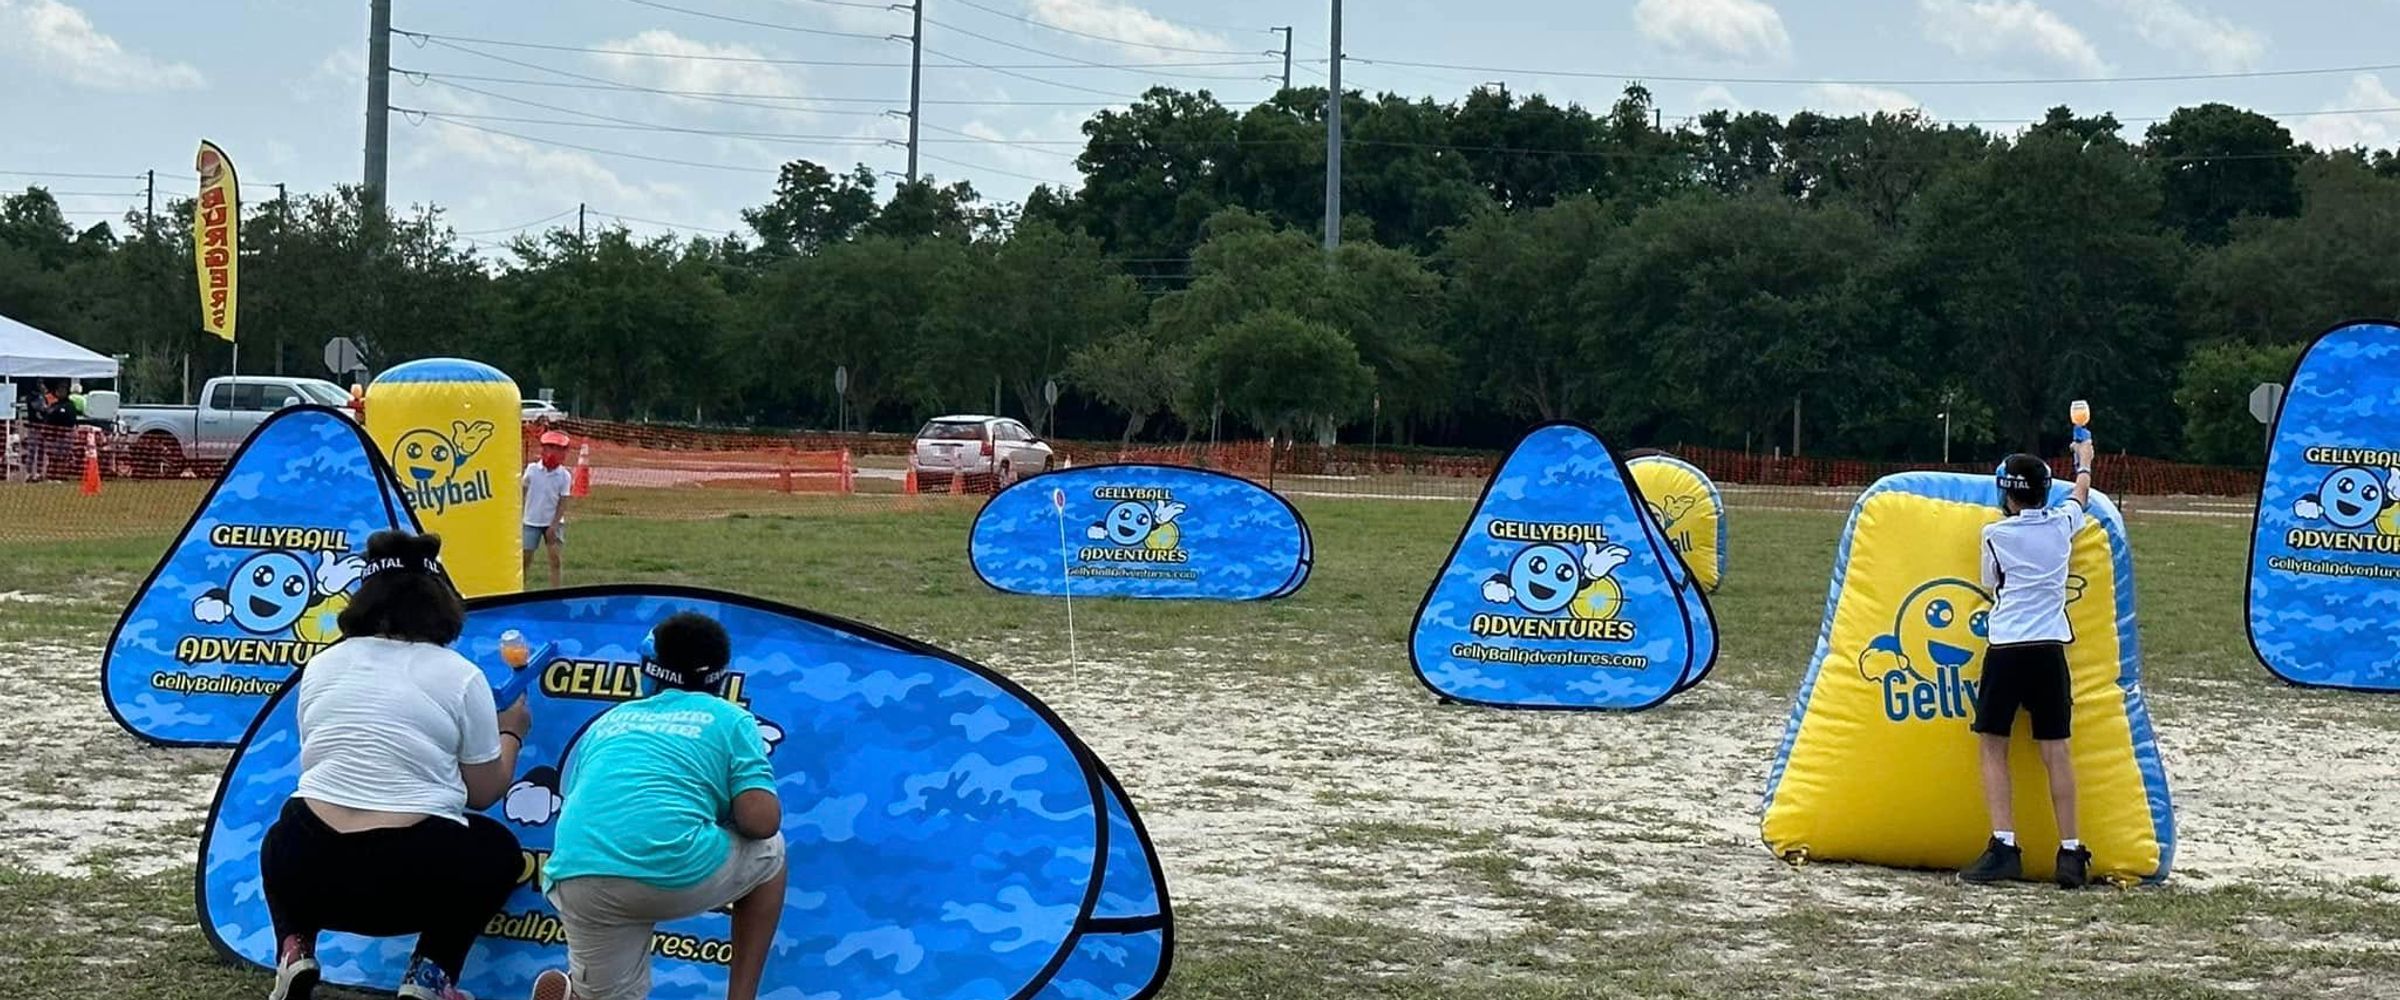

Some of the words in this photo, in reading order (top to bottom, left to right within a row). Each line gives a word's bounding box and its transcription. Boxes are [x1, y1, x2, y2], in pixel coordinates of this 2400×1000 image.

[1095, 487, 1173, 500] GELLYBALL
[211, 525, 350, 551] GELLYBALL
[1489, 520, 1608, 542] GELLYBALL
[1080, 548, 1188, 562] ADVENTURES
[1472, 614, 1634, 640] ADVENTURES
[1451, 644, 1647, 669] GellyBallAdventures.com
[645, 661, 685, 685] RENTAL
